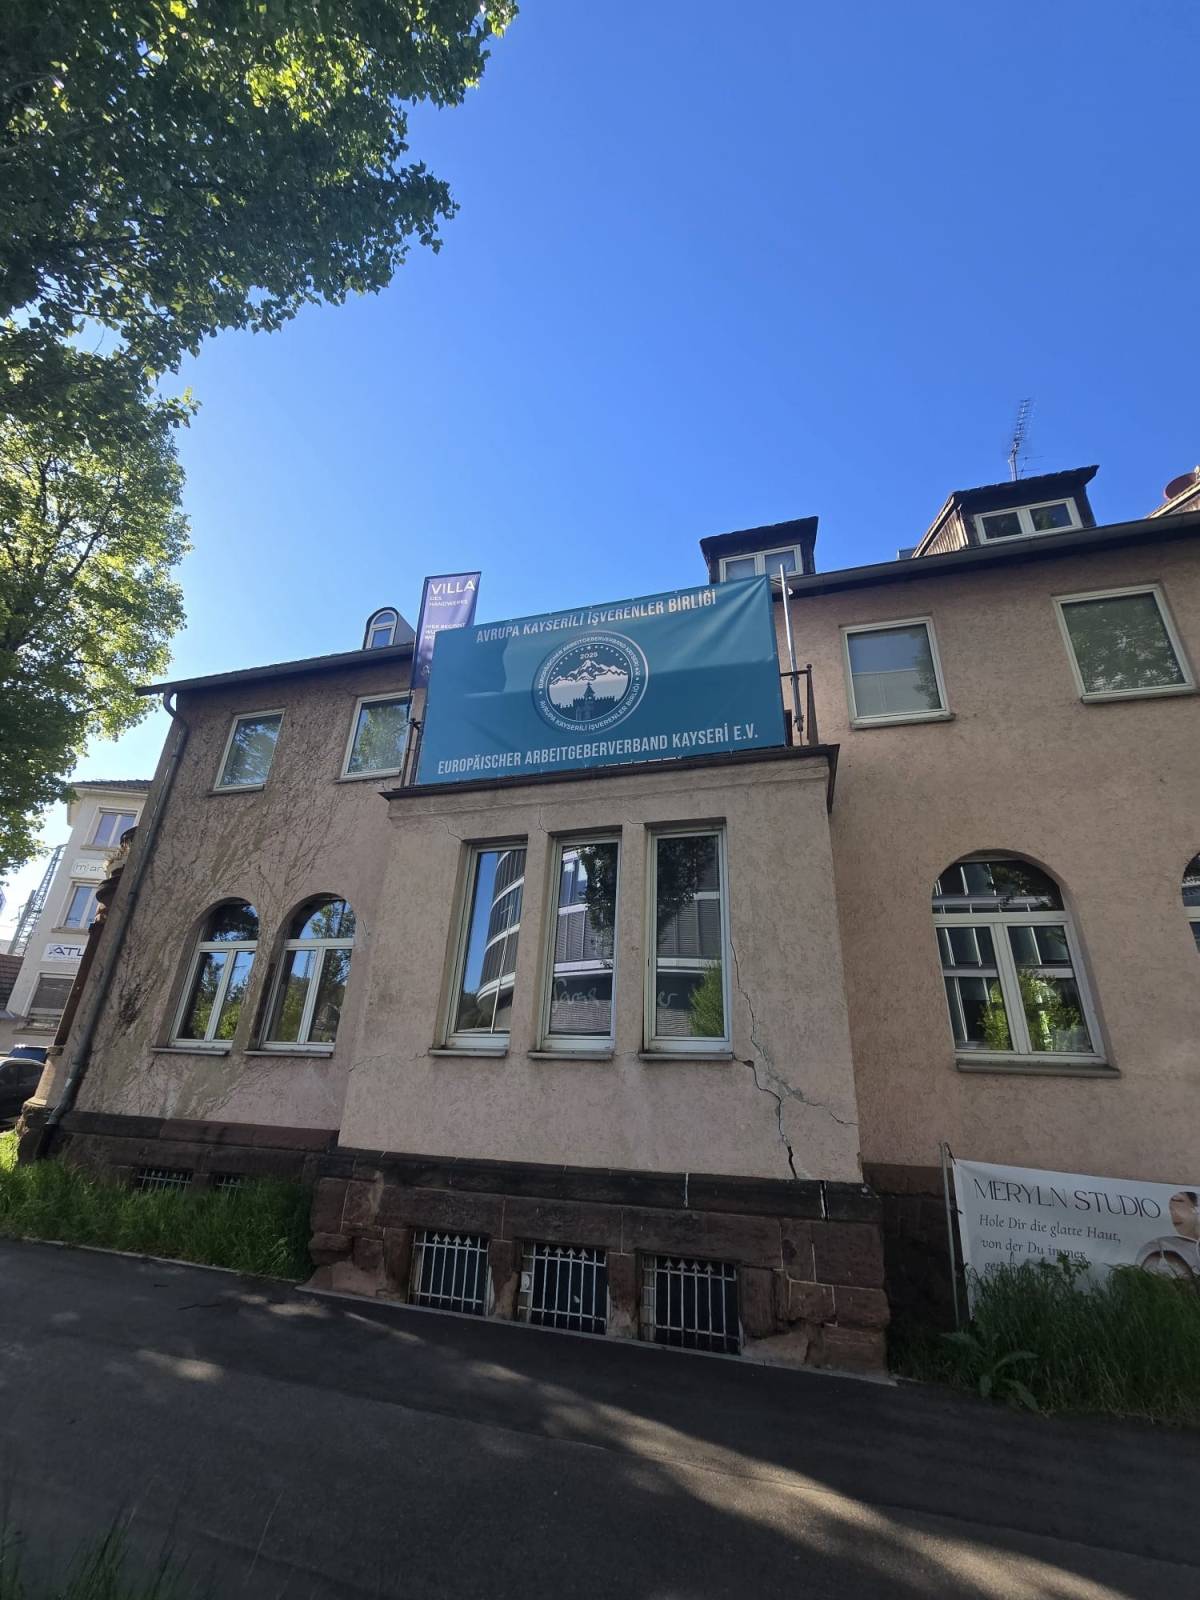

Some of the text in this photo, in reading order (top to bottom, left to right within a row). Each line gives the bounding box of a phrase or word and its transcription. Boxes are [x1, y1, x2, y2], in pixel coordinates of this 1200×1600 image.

[431, 580, 475, 594] VILLA
[476, 588, 716, 644] AVRUPA KAYSERİLİ İŞVERENLER BİRLİĞİ
[438, 723, 759, 775] EUROPÄISCHER ARBEITGEBERVERBAND KAYSERİ E.V.
[973, 1178, 1161, 1219] MERYLN STUDIO
[979, 1214, 1121, 1243] Hole Dir die glatte Haut,
[981, 1239, 1002, 1250] von
[1005, 1238, 1023, 1252] der
[1027, 1241, 1044, 1255] Du
